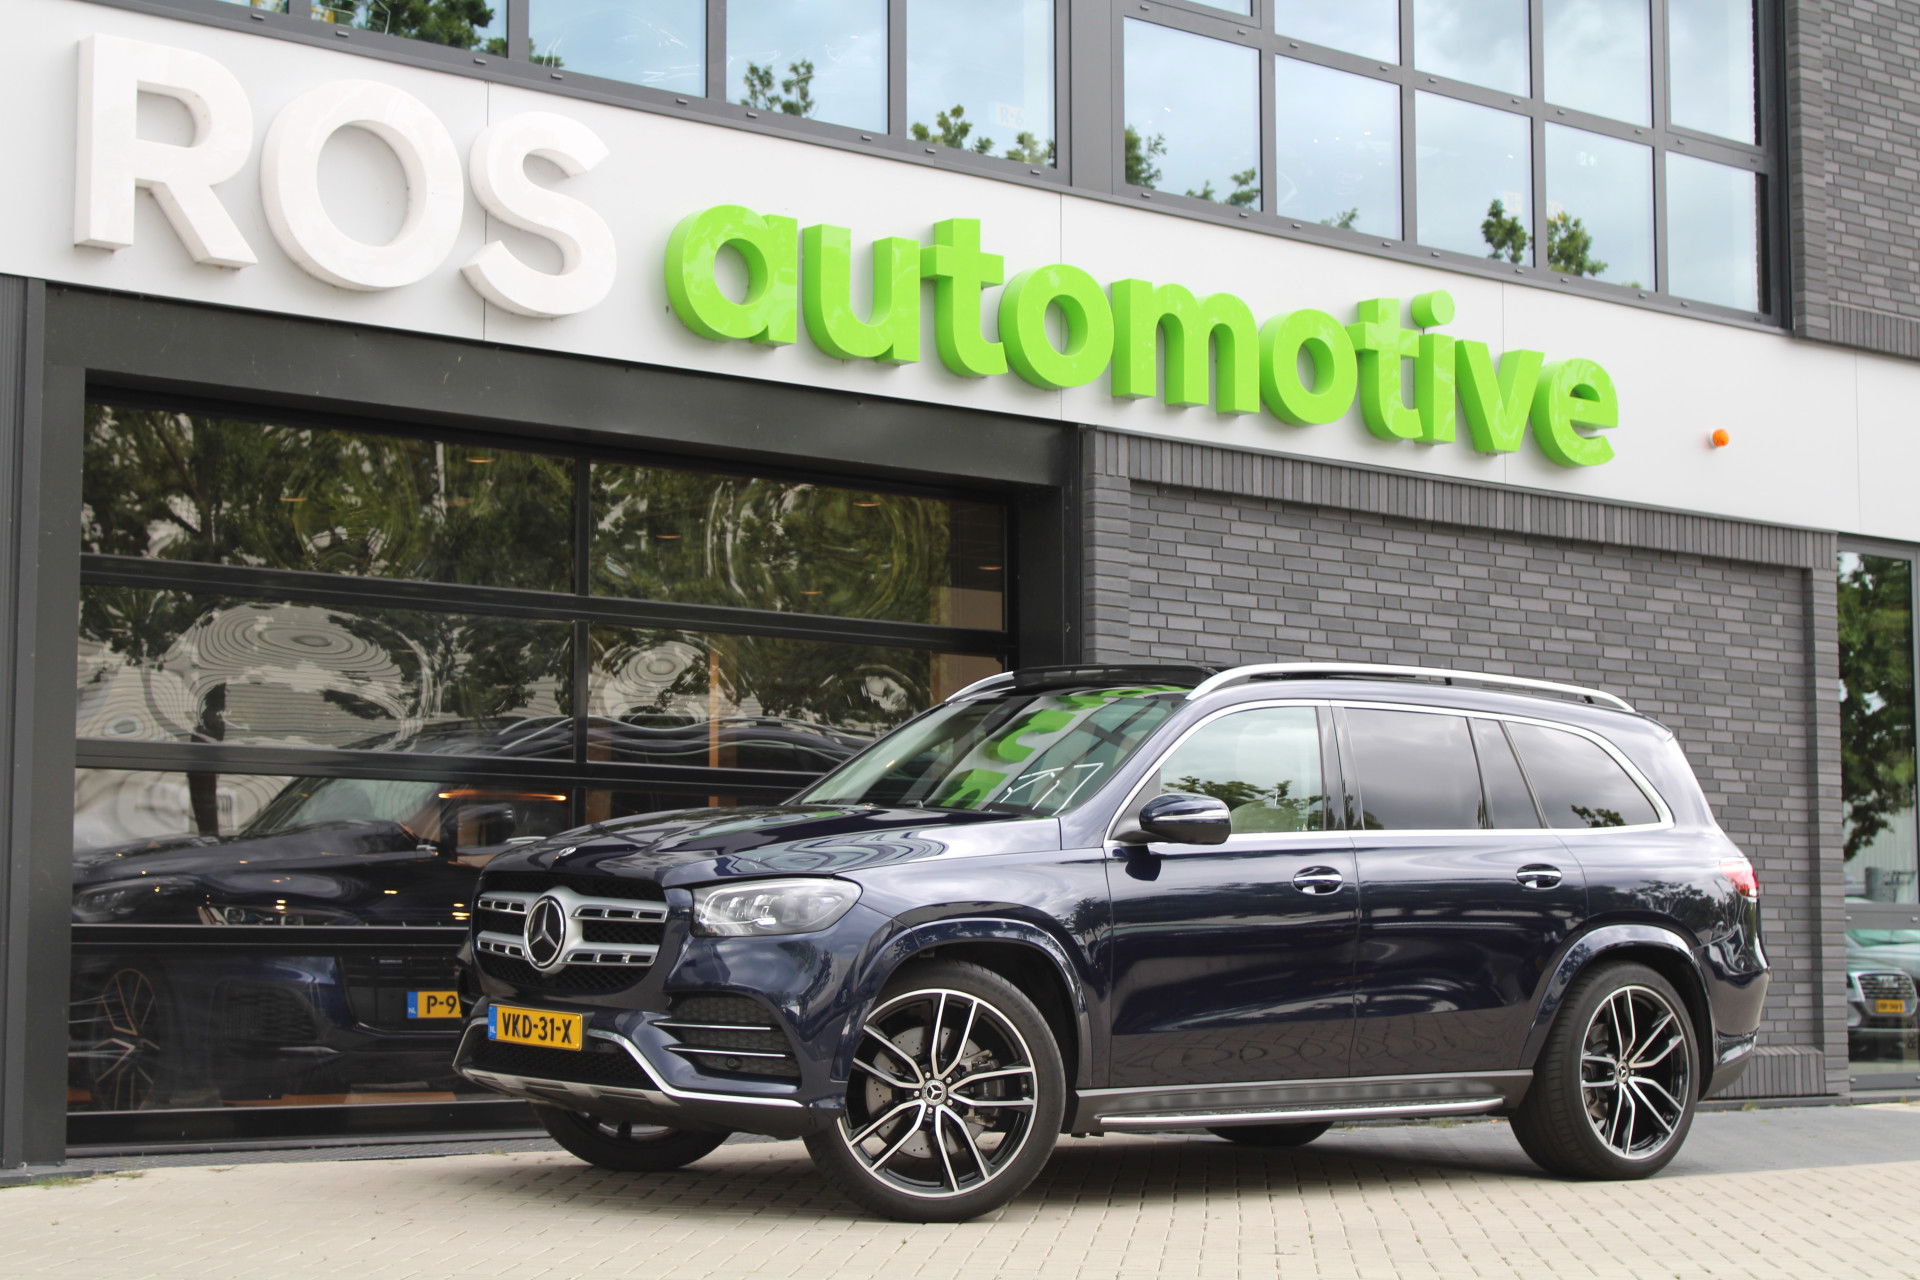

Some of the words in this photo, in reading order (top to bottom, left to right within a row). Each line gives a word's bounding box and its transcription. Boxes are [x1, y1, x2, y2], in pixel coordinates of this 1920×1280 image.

[74, 33, 617, 318] ROS
[664, 203, 1619, 467] automotive
[427, 995, 461, 1015] P-9
[502, 1013, 572, 1044] VKD-31-X
